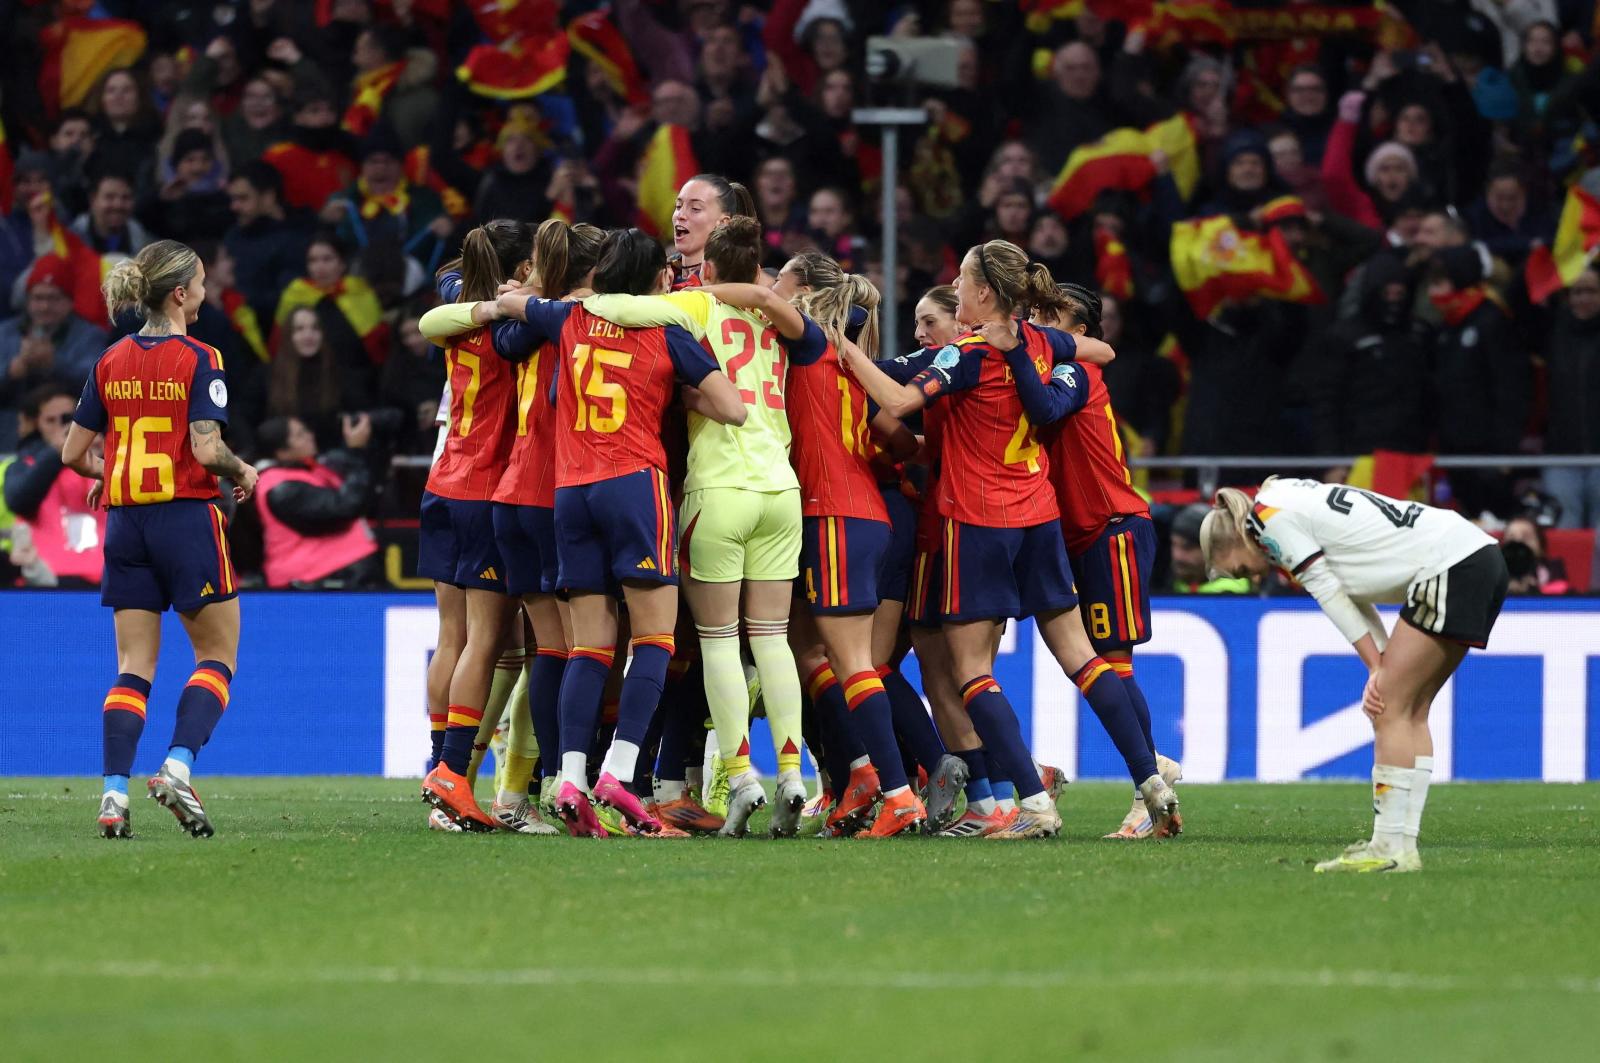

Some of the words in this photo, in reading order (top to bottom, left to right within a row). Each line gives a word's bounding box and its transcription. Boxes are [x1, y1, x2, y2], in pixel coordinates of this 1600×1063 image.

[588, 319, 625, 339] LEILA
[721, 318, 788, 410] 23
[105, 376, 143, 400] MARÍA
[150, 377, 187, 401] LEÓN
[572, 343, 633, 434] 15
[110, 416, 175, 507] 16
[1004, 411, 1041, 474] 4
